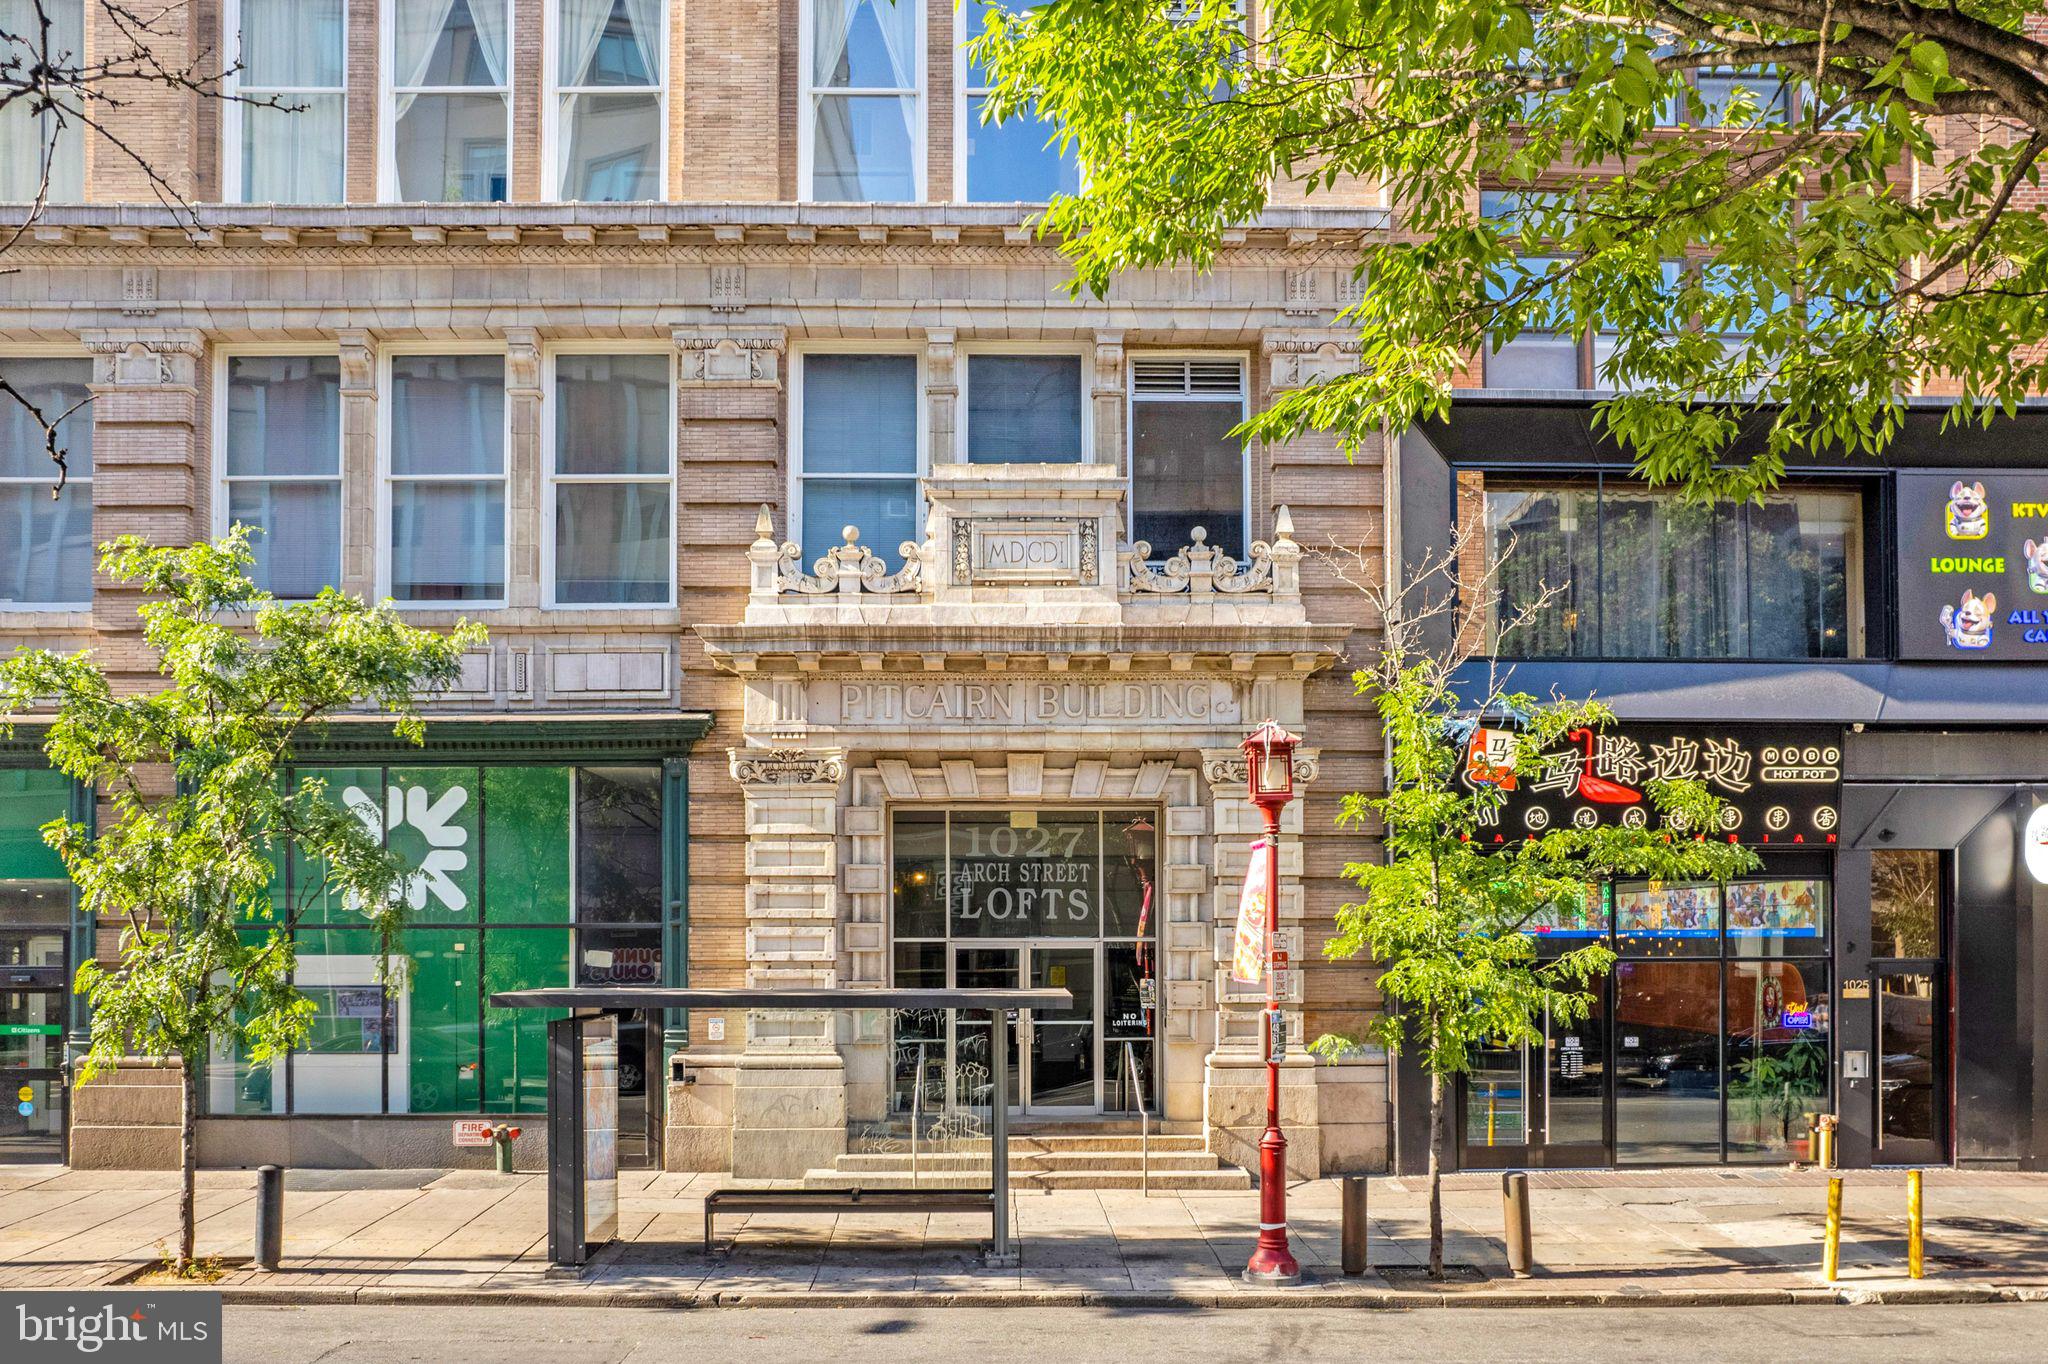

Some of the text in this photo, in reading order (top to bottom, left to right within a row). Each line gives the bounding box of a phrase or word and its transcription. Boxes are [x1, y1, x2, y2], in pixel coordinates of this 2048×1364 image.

[988, 540, 1064, 564] MDCDI
[1931, 557, 2005, 573] LOUNGE
[2008, 609, 2040, 624] ALL
[2024, 628, 2048, 643] CA
[841, 684, 1208, 719] PITCAIRN BUILDING
[1773, 769, 1827, 779] HOT POT
[965, 827, 1085, 858] 1027
[960, 863, 1091, 883] ARCH STREET
[960, 888, 1089, 921] LOFTS
[1843, 980, 1869, 990] 1025
